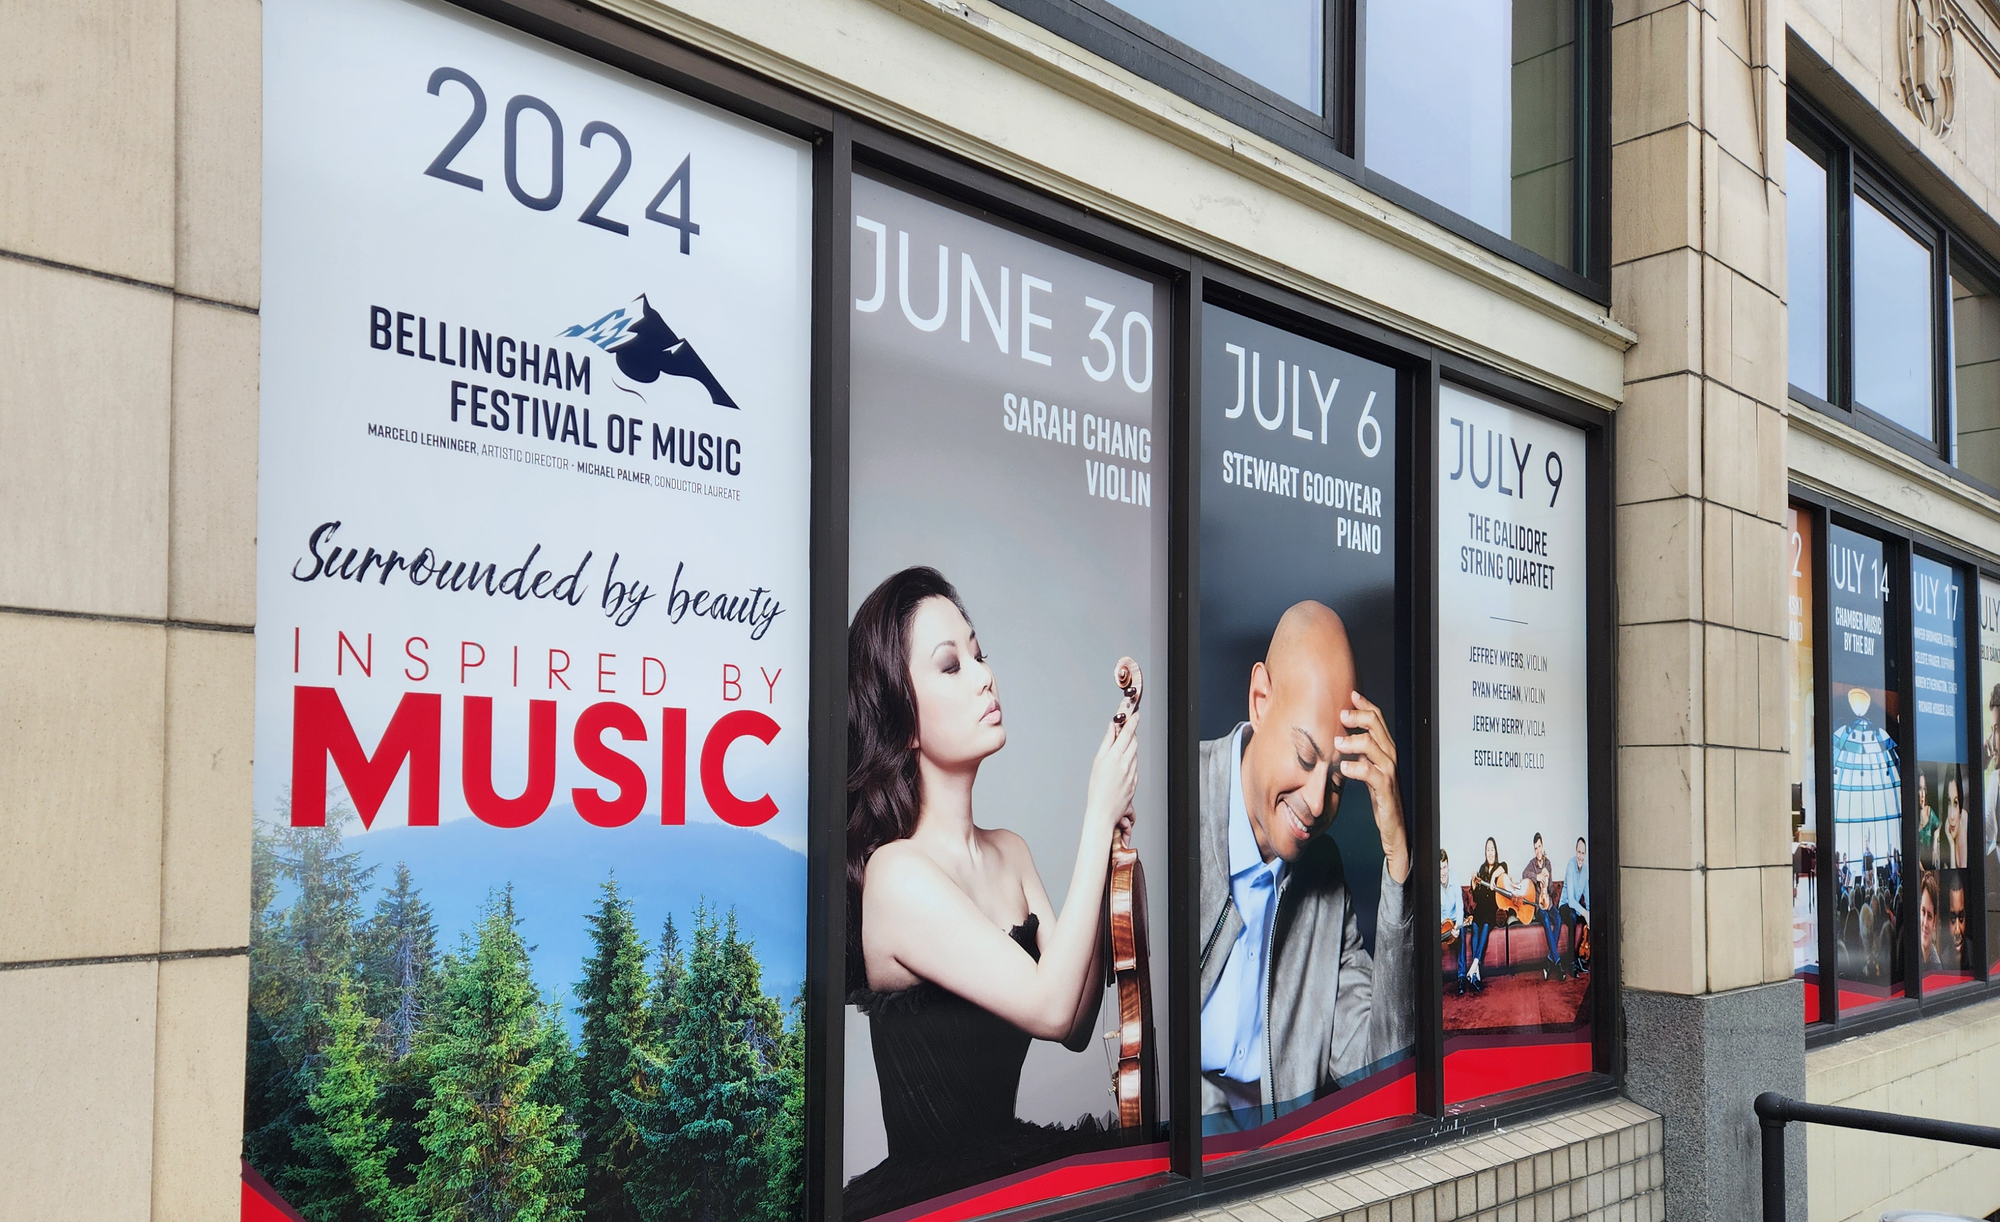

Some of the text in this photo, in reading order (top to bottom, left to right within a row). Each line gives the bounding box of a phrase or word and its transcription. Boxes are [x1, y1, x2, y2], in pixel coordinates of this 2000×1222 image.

[423, 66, 700, 255] 2024
[855, 215, 1153, 393] JUNE 30
[369, 303, 591, 396] BELLINGHAM
[1225, 342, 1382, 458] JULY 6
[449, 380, 741, 476] FESTIVAL OF MUSIC
[1003, 392, 1151, 464] SARAH CHANG
[367, 422, 741, 502] MARCELO LEHNINGER, ARTISTIC DIRECTOR MICHAEL PALMER, CONDUCTOR LAUREATE
[1085, 459, 1151, 508] VIOLIN
[1222, 450, 1382, 518] STEWART GOODYEAR
[1450, 417, 1563, 508] JULY 9
[1336, 516, 1382, 555] PIANO
[1468, 512, 1548, 557] THE CALIDORE
[1791, 531, 1802, 578] 2
[291, 520, 786, 641] Surrounded by beauty
[1460, 545, 1555, 591] STRING QUARTET
[1871, 558, 1890, 602] 14
[1835, 606, 1882, 635] CHAMBER MUSIC
[1913, 571, 1959, 621] ULY 17
[1979, 593, 2000, 634] ULY
[293, 626, 783, 705] INSPIRED BY
[1469, 645, 1548, 672] JEFFREY MYERS, VIOLIN
[1843, 632, 1875, 656] BY THE BAY
[1472, 680, 1491, 699] RYAN
[1524, 686, 1545, 704] VIOLIN
[1472, 715, 1546, 737] JEREMY BERRY, VIOLA
[290, 684, 782, 832] MUSIC
[1474, 749, 1503, 767] ESTELLE
[1524, 752, 1545, 770] CELLO
